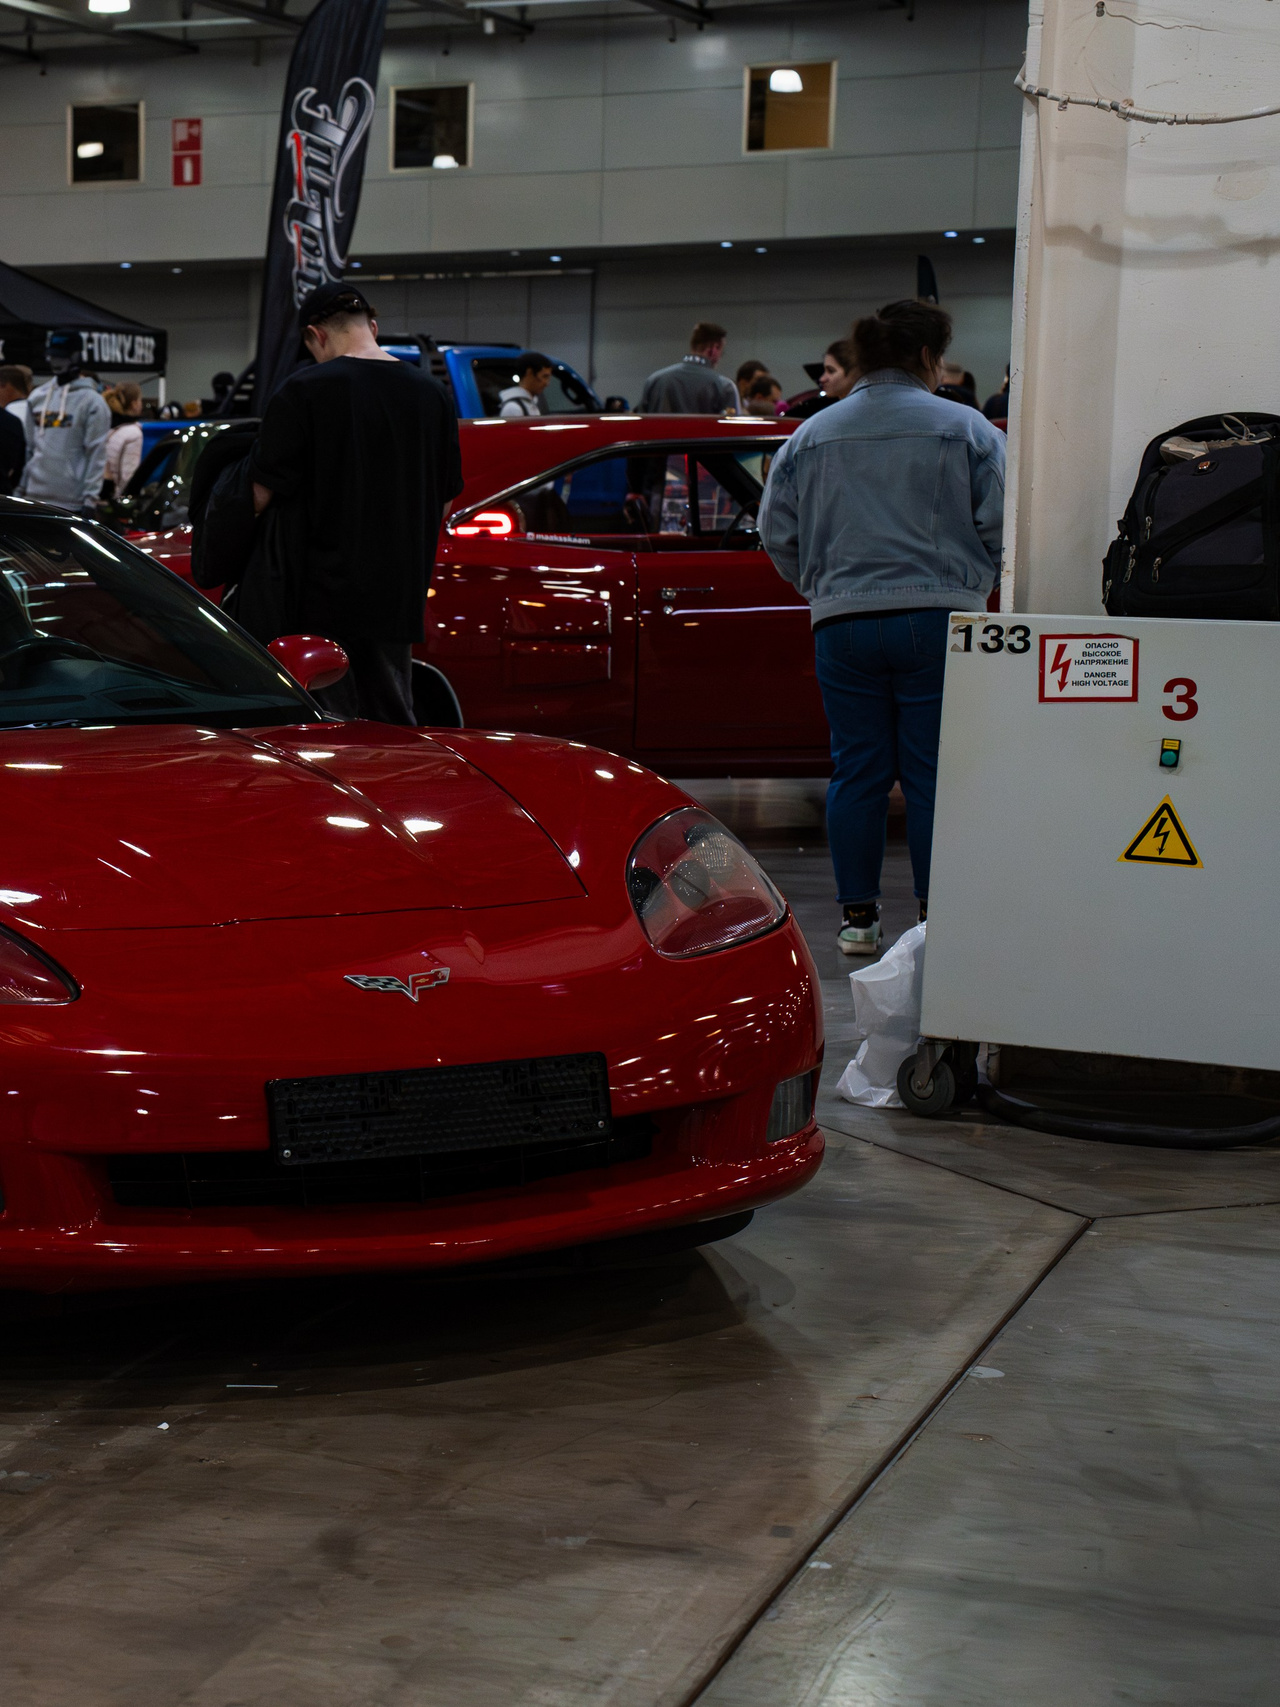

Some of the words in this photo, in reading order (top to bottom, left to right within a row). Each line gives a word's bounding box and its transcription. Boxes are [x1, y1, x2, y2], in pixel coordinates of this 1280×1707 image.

[958, 624, 1031, 654] 133
[1092, 679, 1129, 687] VOLTAGE
[1162, 677, 1199, 721] 3
